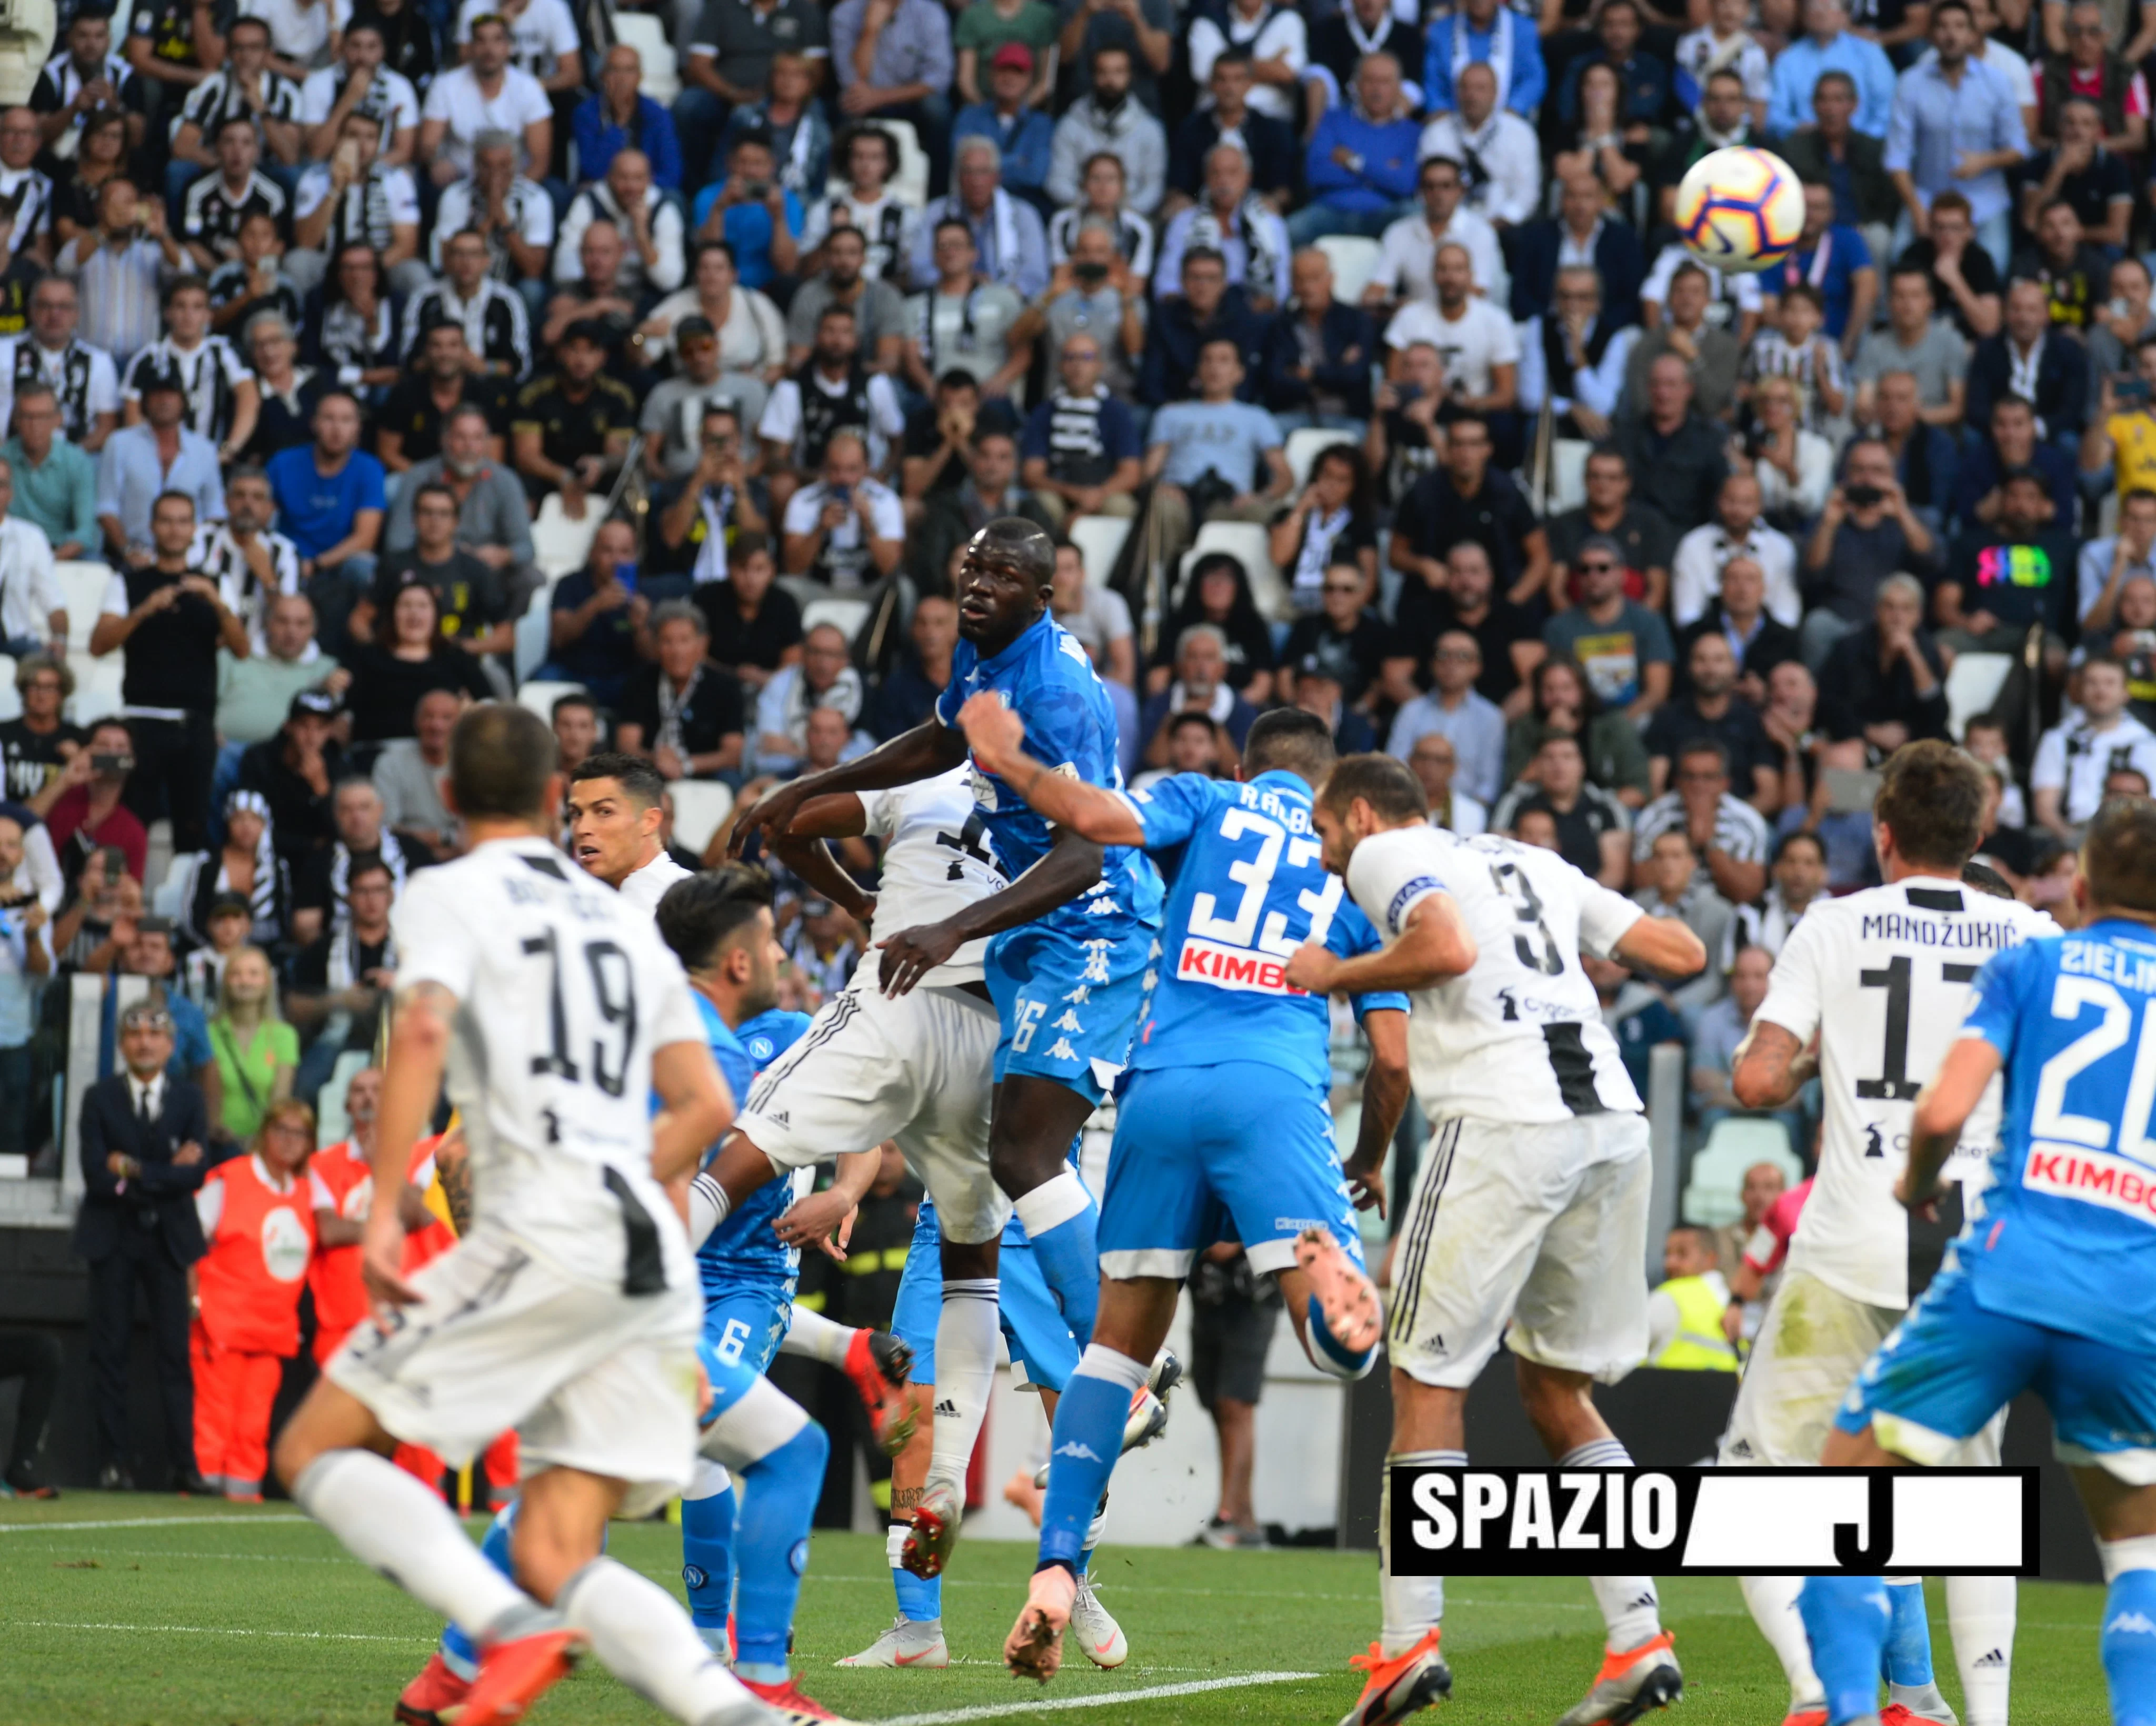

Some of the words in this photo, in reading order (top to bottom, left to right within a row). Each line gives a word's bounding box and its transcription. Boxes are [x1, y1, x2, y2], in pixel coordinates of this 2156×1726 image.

[1187, 806, 1345, 961] 33
[1489, 863, 1564, 976] 3
[1862, 912, 2018, 949] MANDŽUKIĆ
[521, 922, 637, 1098] 19
[716, 1317, 751, 1368] 6
